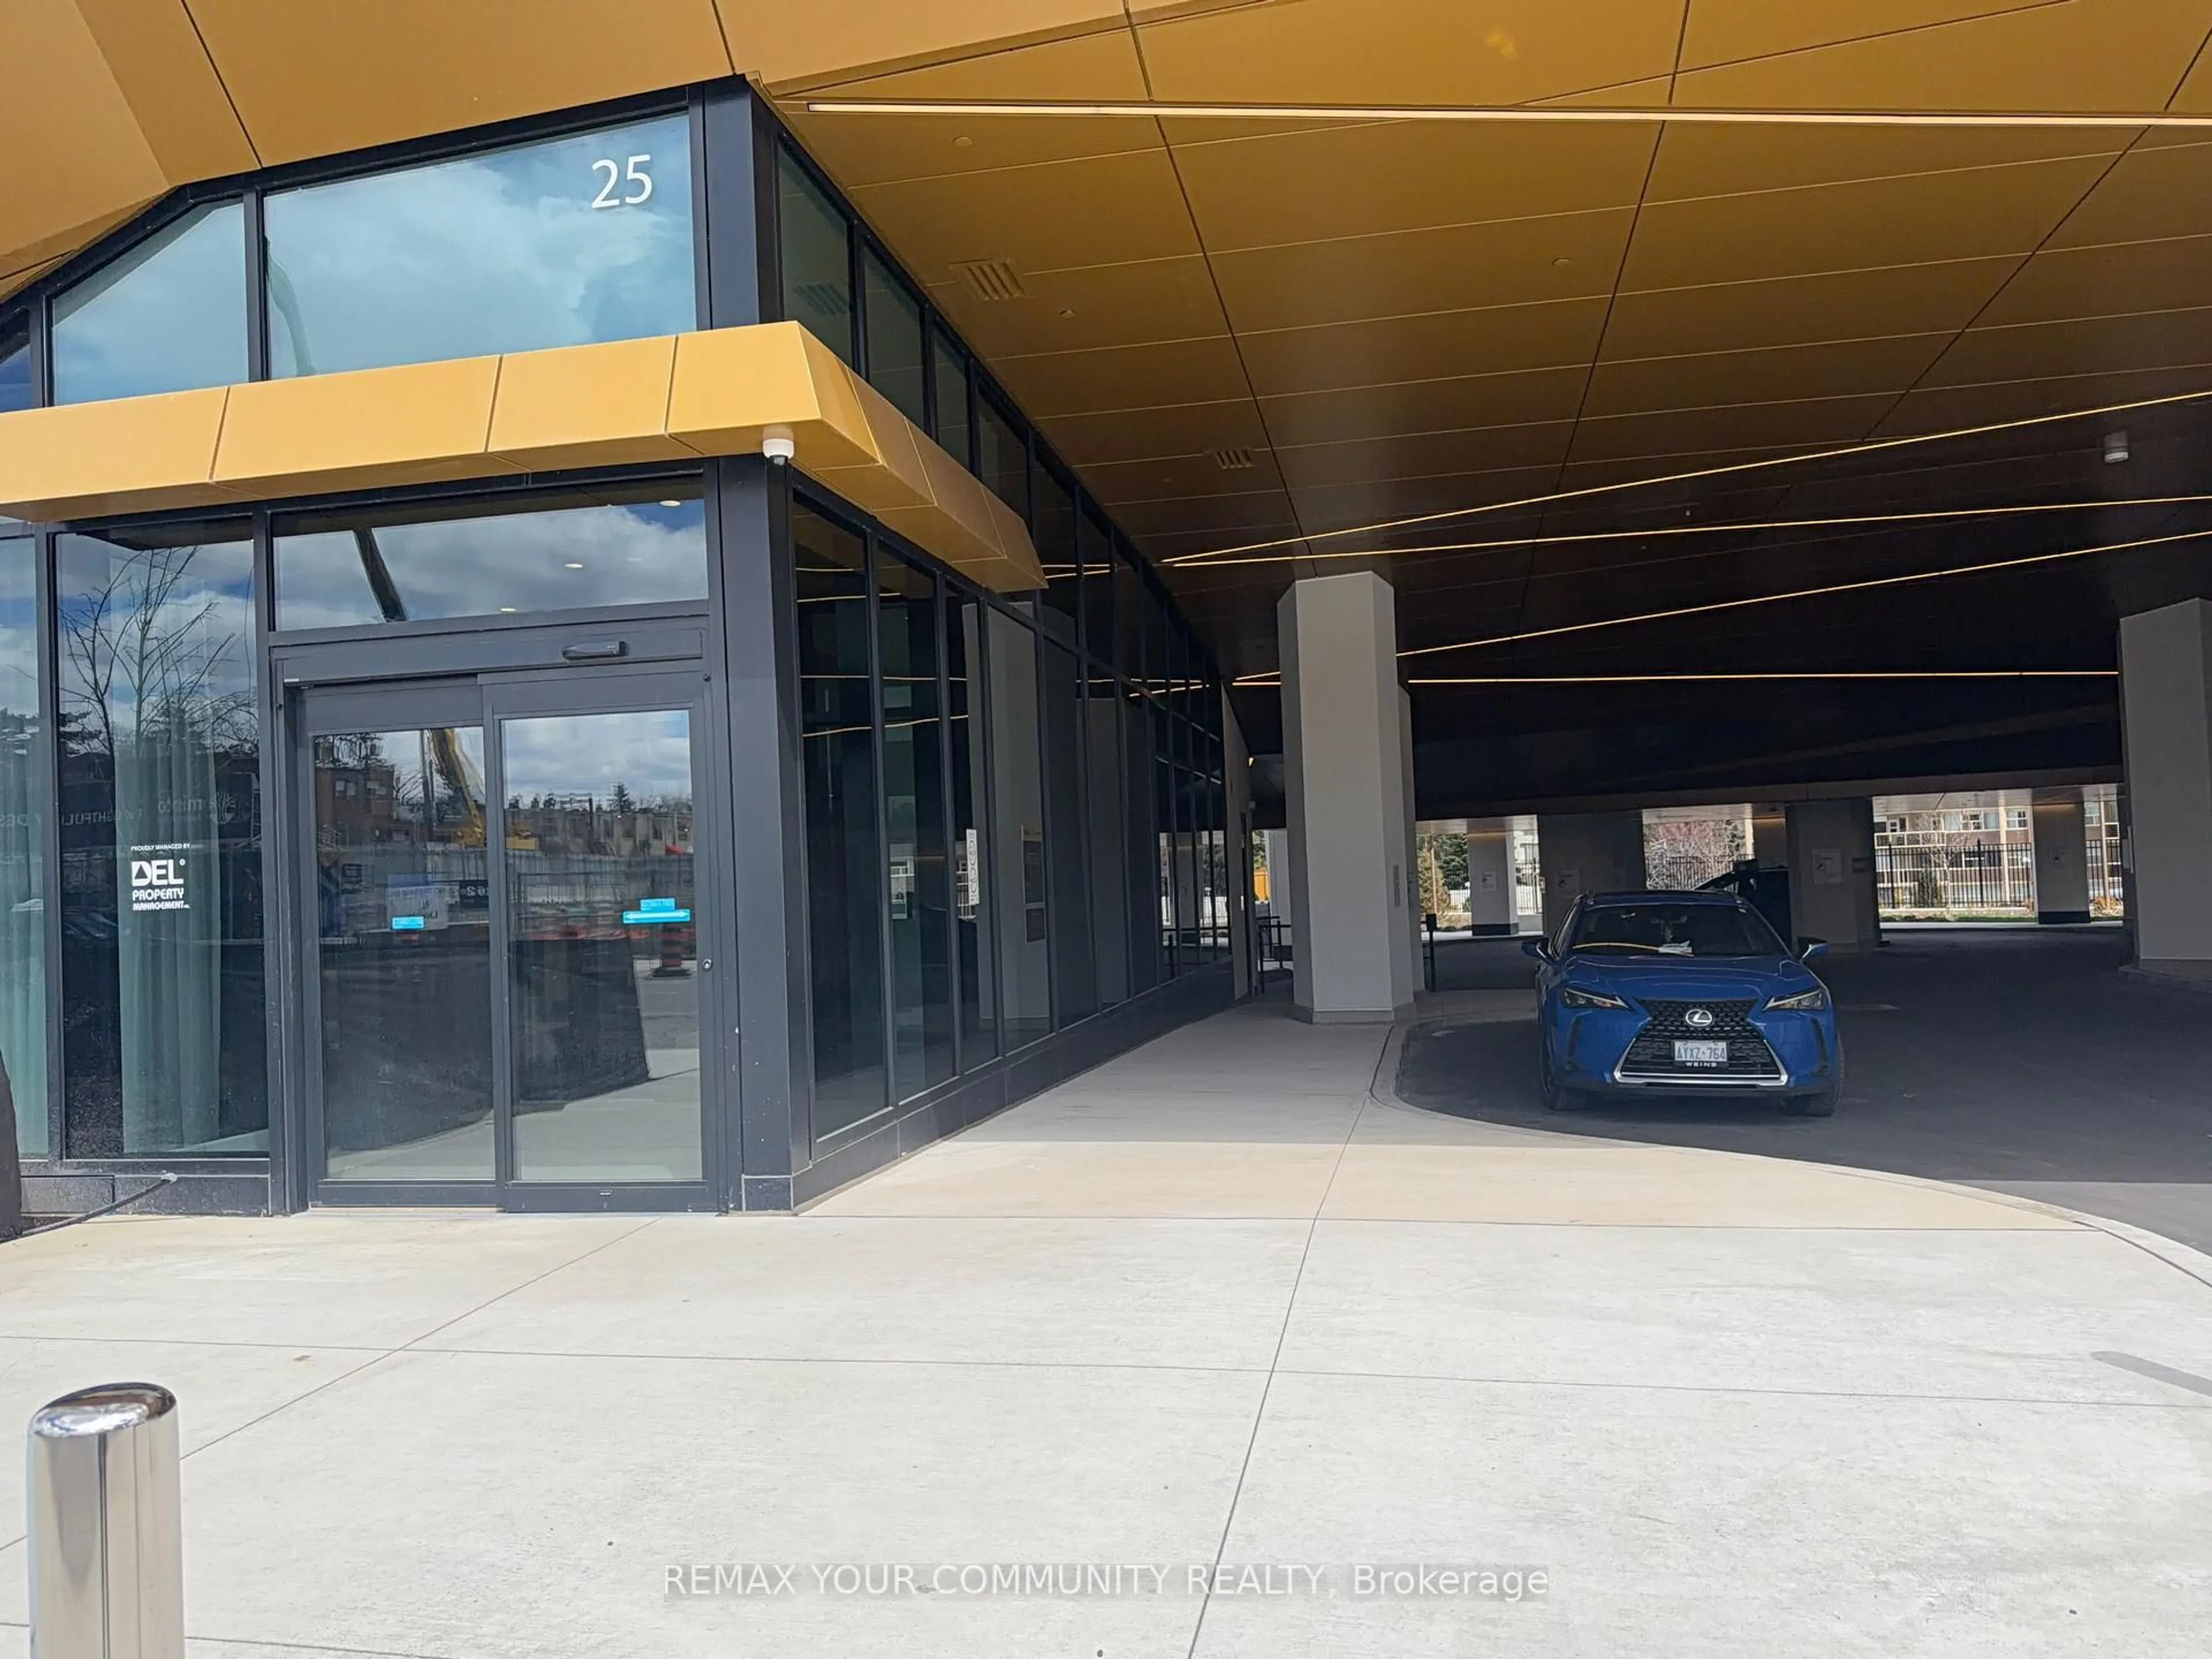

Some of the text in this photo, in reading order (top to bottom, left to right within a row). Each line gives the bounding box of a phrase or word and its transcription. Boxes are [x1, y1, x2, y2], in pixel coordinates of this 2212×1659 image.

[591, 154, 652, 208] 25
[132, 887, 184, 901] PROPERTY
[132, 900, 184, 911] MANAGEMENT
